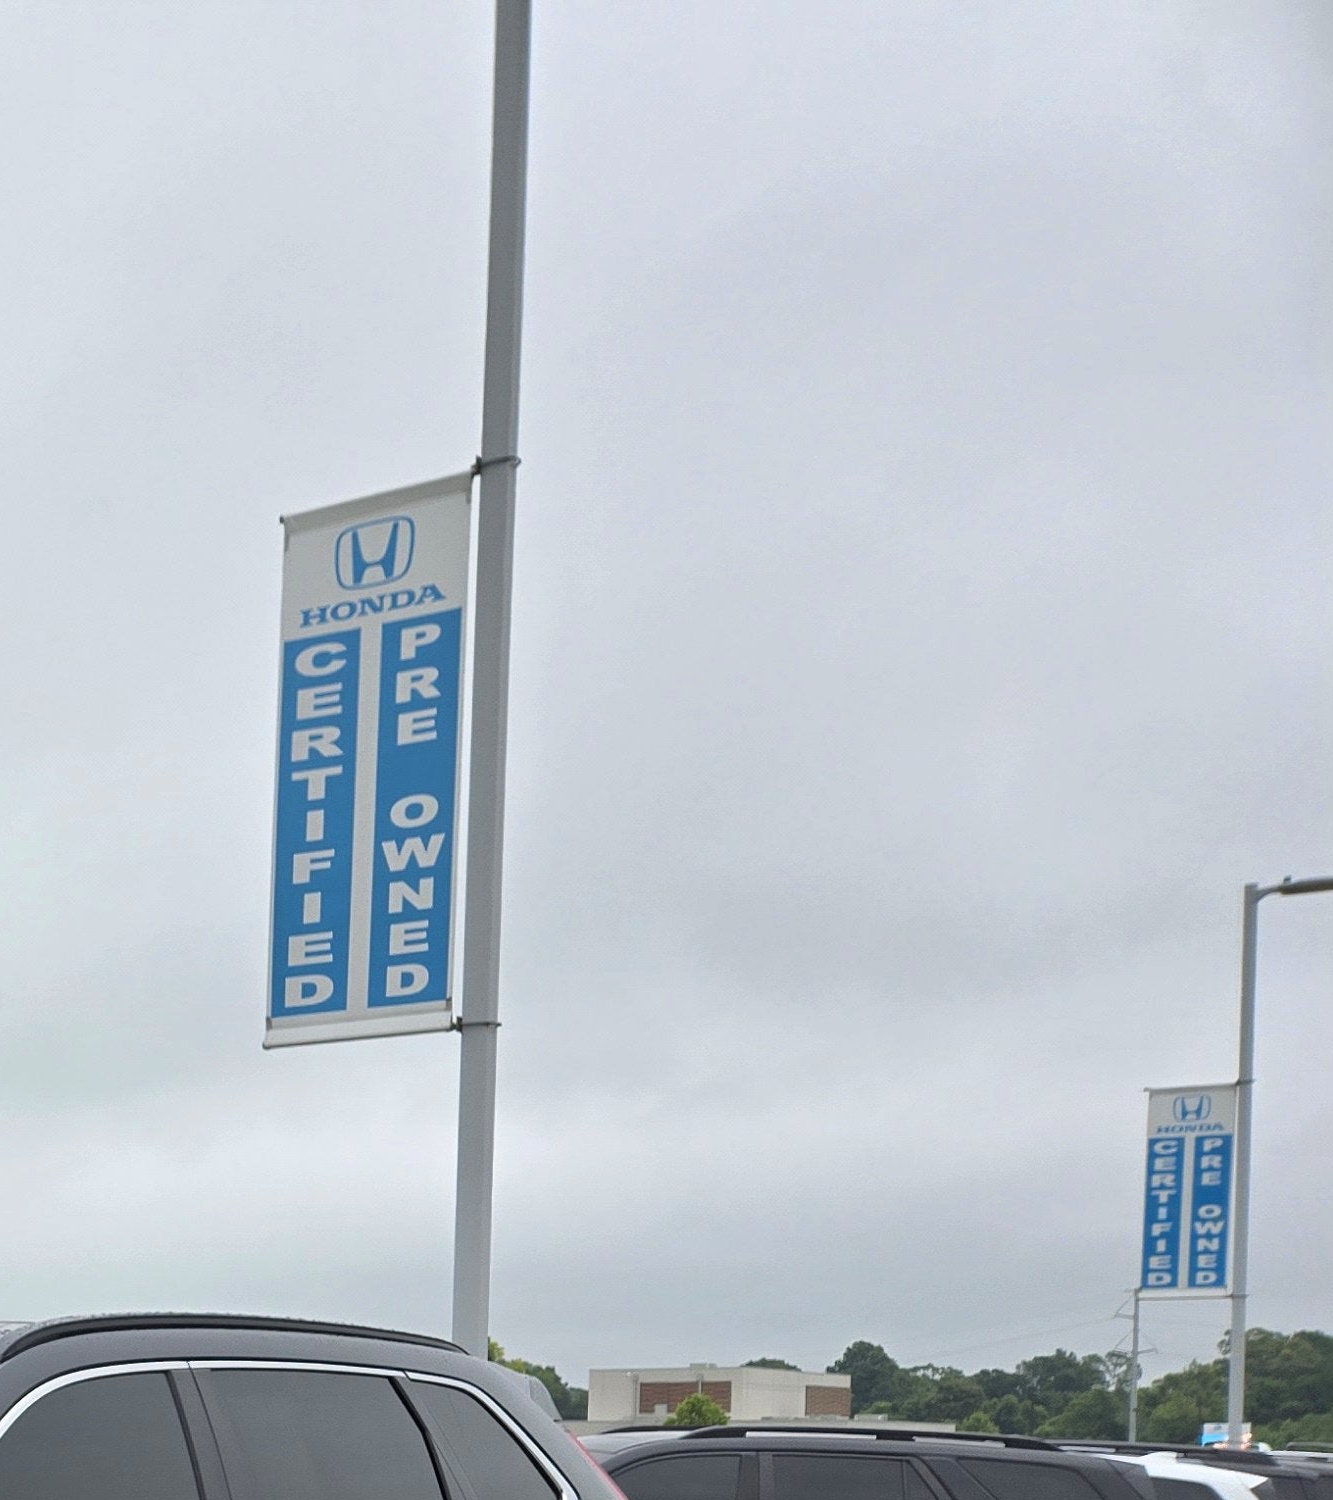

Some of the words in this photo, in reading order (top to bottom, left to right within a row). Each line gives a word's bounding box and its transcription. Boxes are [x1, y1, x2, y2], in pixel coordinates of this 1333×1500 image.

[299, 583, 447, 628] HONDA
[394, 622, 442, 746] PRE
[283, 642, 348, 1009] CERTIFIED
[381, 793, 446, 998] OWNED
[1155, 1123, 1224, 1134] HONDA
[1200, 1137, 1224, 1186] PRE
[1147, 1139, 1179, 1287] CERTIFIED
[1193, 1203, 1226, 1287] OWNED
